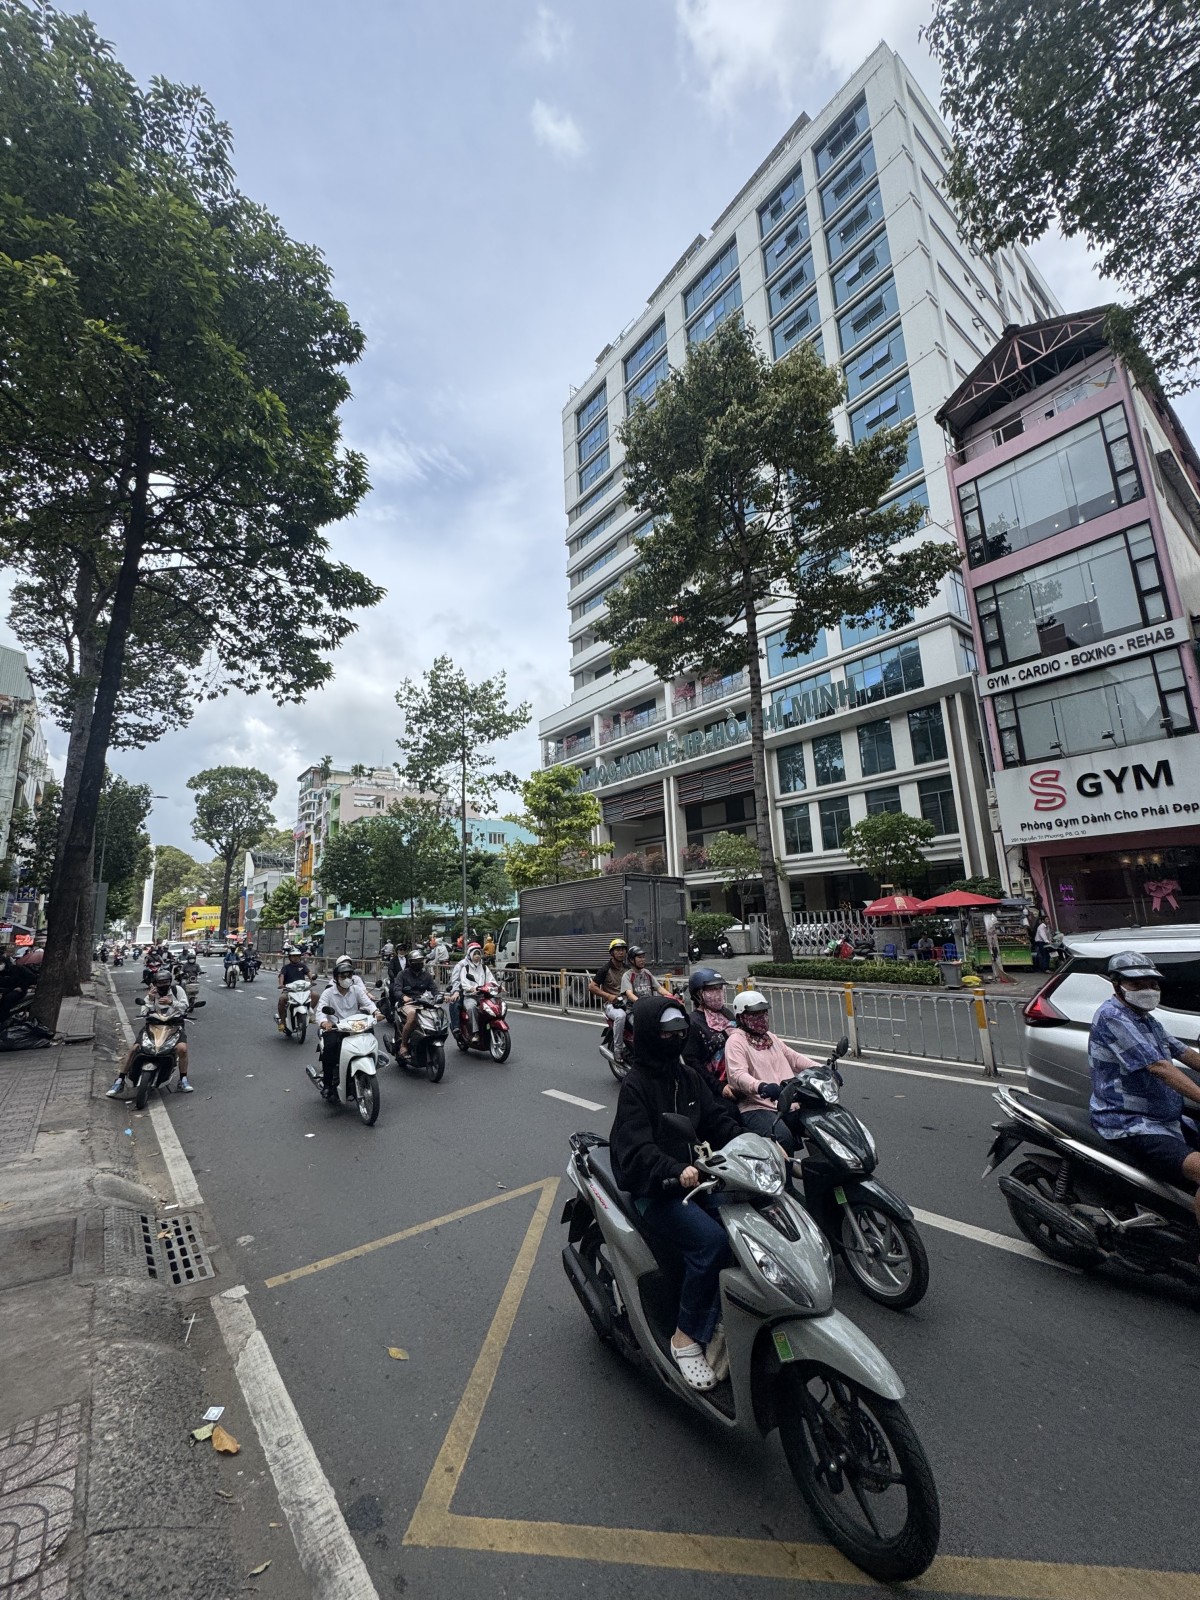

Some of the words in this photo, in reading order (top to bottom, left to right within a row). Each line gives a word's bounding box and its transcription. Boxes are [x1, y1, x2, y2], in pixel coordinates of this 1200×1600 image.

[987, 674, 1010, 690] GYM
[1018, 659, 1061, 681] CARDIO
[1071, 643, 1116, 667] BOXING
[1127, 627, 1175, 651] REHAB
[620, 747, 656, 778] KINH
[711, 707, 740, 747] HỒ
[791, 676, 857, 723] MINH
[1076, 759, 1174, 798] GYM
[1020, 818, 1053, 832] Phòng
[1055, 817, 1079, 828] Gym
[1082, 810, 1112, 824] Dành
[1114, 810, 1138, 820] Cho
[1141, 804, 1169, 818] Phái
[1172, 801, 1200, 814] Đẹp
